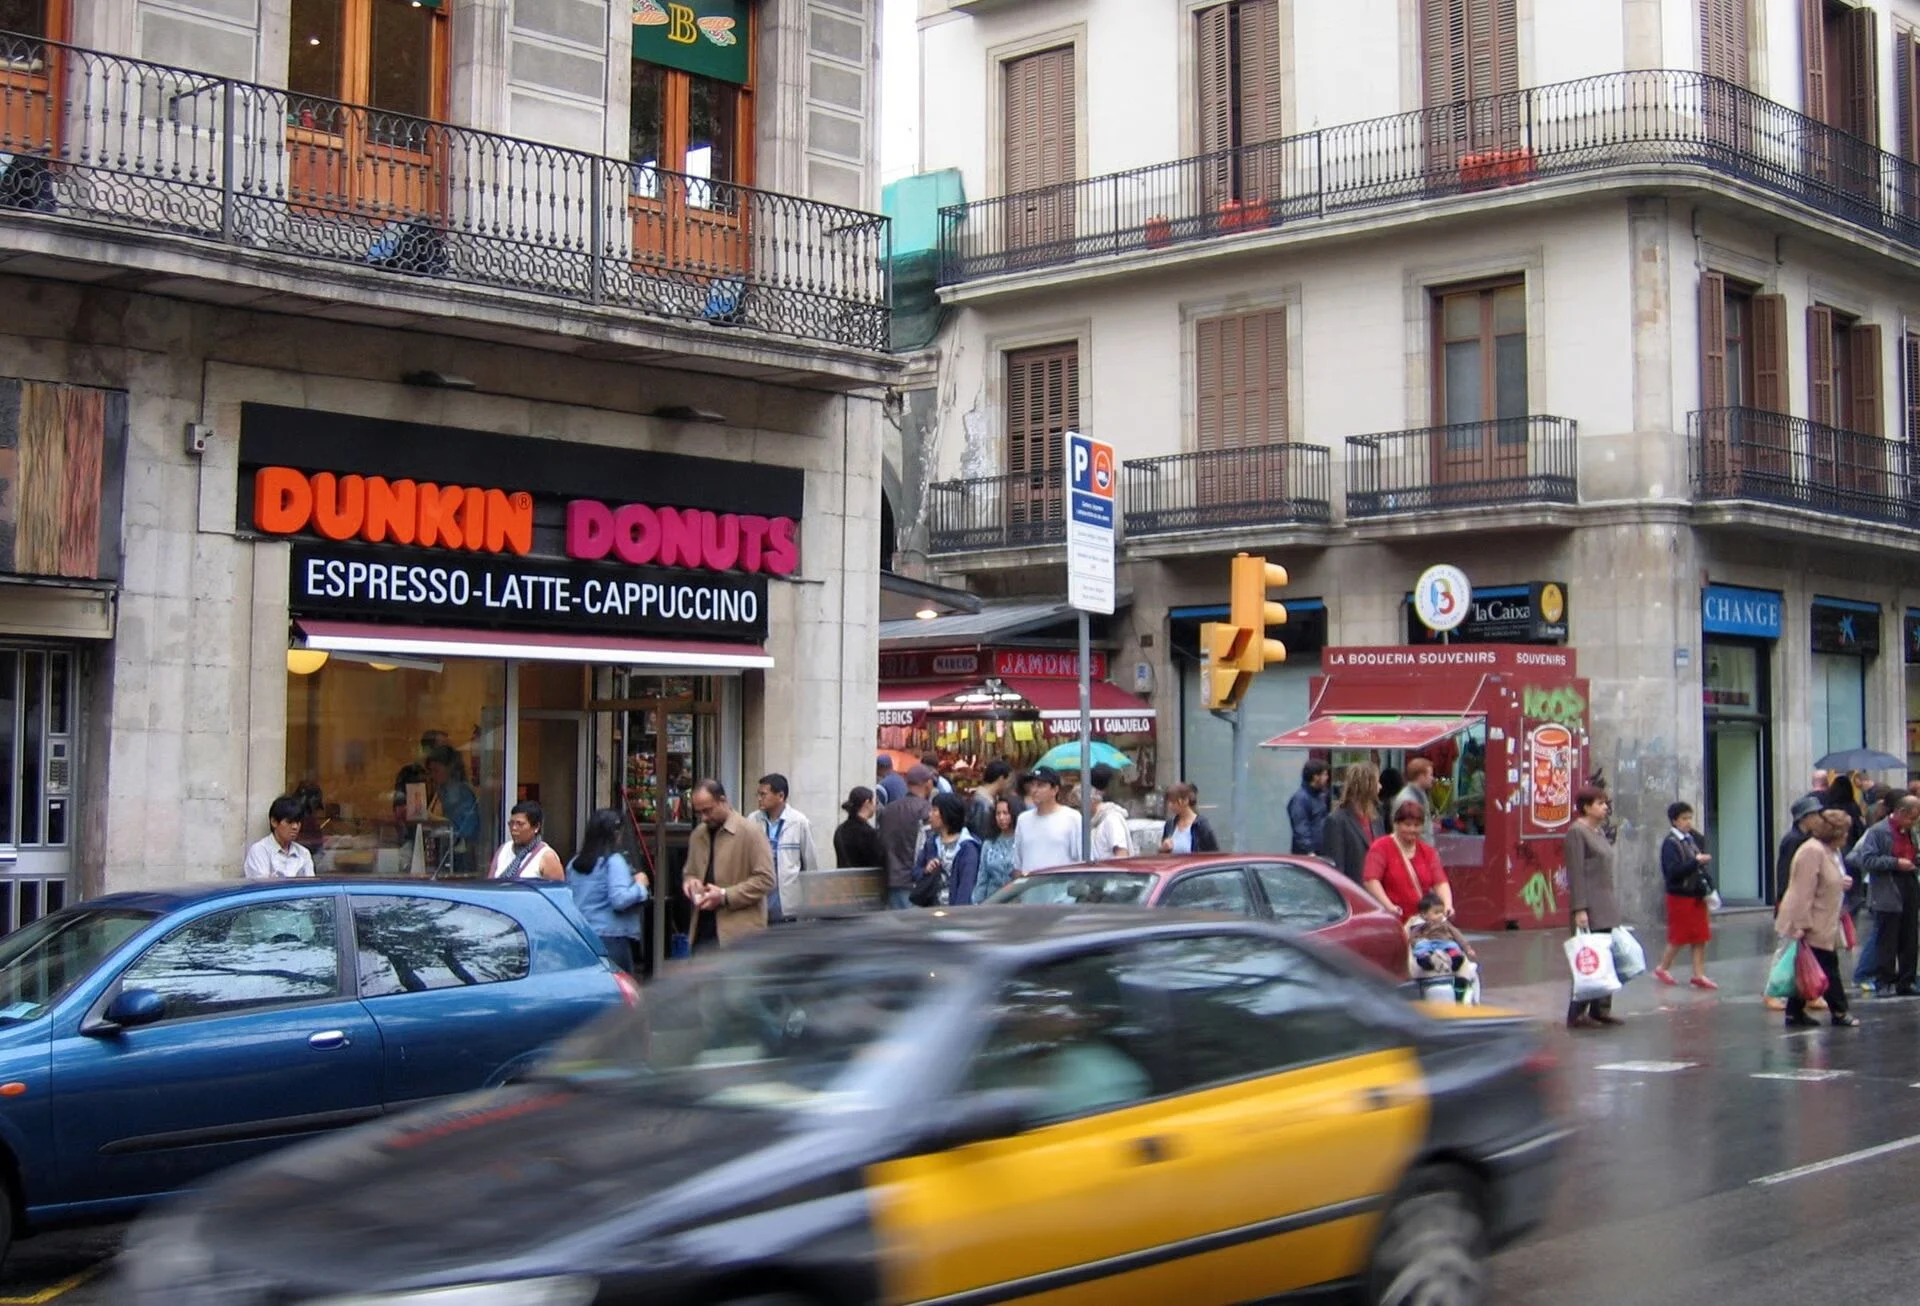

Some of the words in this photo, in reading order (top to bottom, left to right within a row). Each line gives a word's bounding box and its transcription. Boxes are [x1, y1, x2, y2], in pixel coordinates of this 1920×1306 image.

[667, 2, 698, 45] B
[1074, 444, 1089, 482] P
[565, 499, 798, 576] DONUTS
[1705, 595, 1778, 627] CHANGE
[1330, 653, 1346, 665] LA
[1348, 652, 1416, 665] BOQUERIA
[1419, 651, 1497, 665] SOUVENIRS
[1516, 651, 1567, 666] SOUVENIRS
[1049, 718, 1092, 734] JABU
[1103, 717, 1150, 733] GUIJUELO
